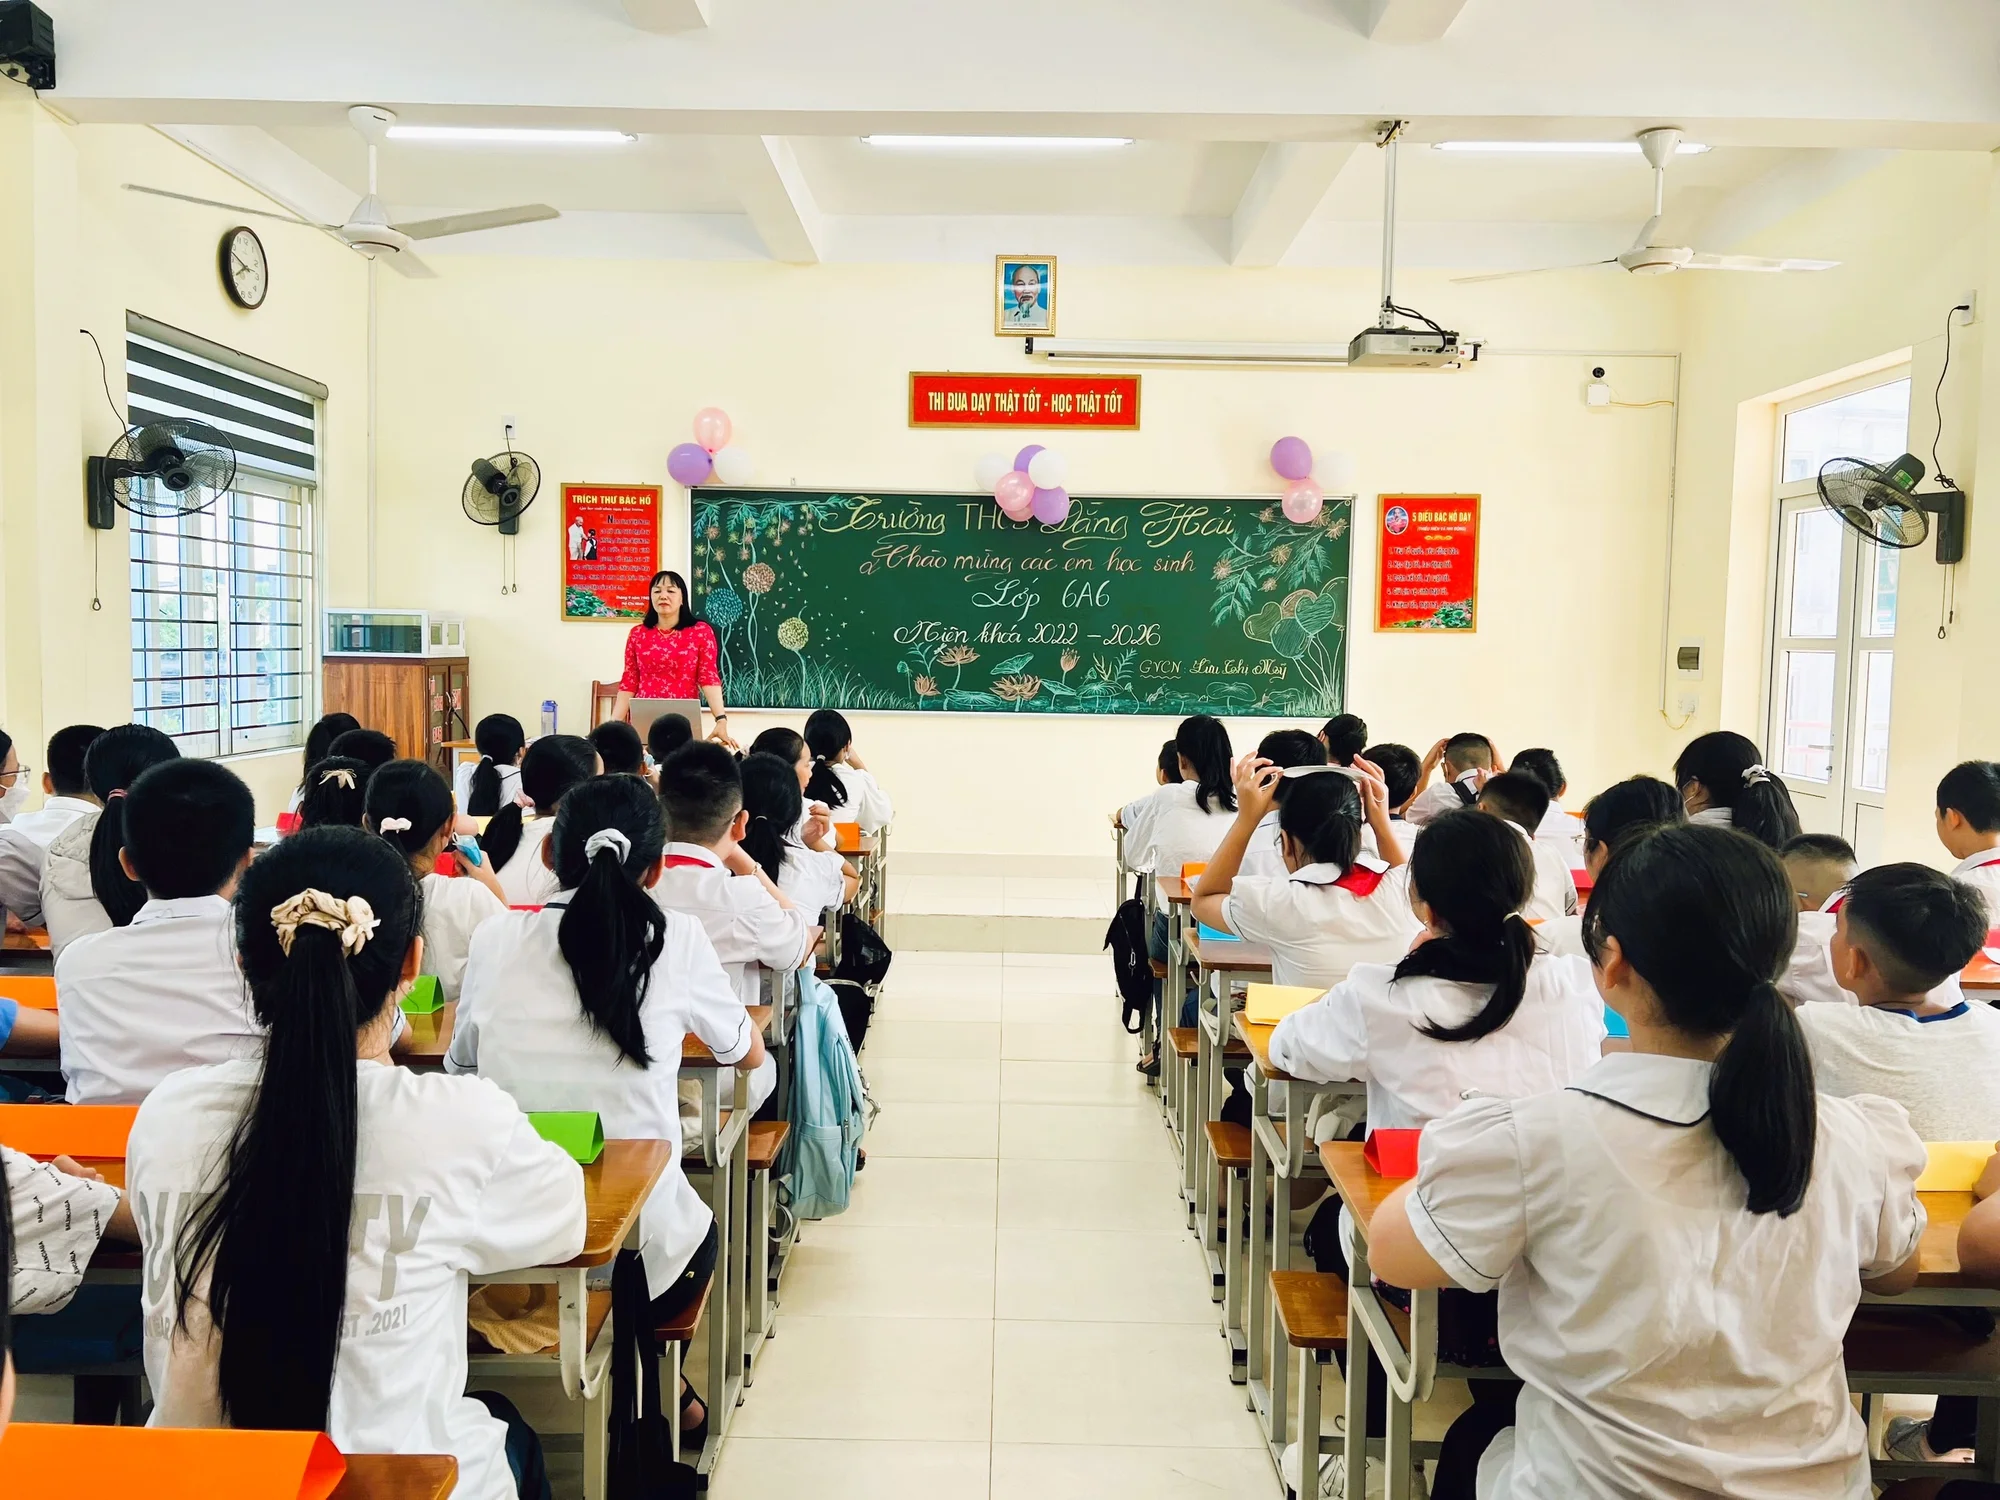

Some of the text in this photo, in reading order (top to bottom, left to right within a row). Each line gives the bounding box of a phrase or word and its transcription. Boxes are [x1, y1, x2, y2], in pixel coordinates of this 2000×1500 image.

[928, 391, 944, 412] THI
[947, 392, 968, 412] ĐUA
[971, 392, 992, 416] DẠY
[994, 389, 1020, 416] THẬT
[1023, 386, 1042, 413] TỐT
[1051, 393, 1073, 417] HỌC
[1075, 390, 1101, 418] THẬT
[1104, 387, 1123, 413] TỐT
[572, 493, 651, 505] TRÍCH THƯ BÁC HỒ
[1412, 512, 1417, 522] 5
[1020, 549, 1058, 572] các
[1061, 556, 1096, 573] em
[1102, 546, 1143, 576] học
[1152, 549, 1197, 573] sinh
[970, 576, 1111, 622] Lớp 6A6
[1027, 622, 1079, 646] 2022
